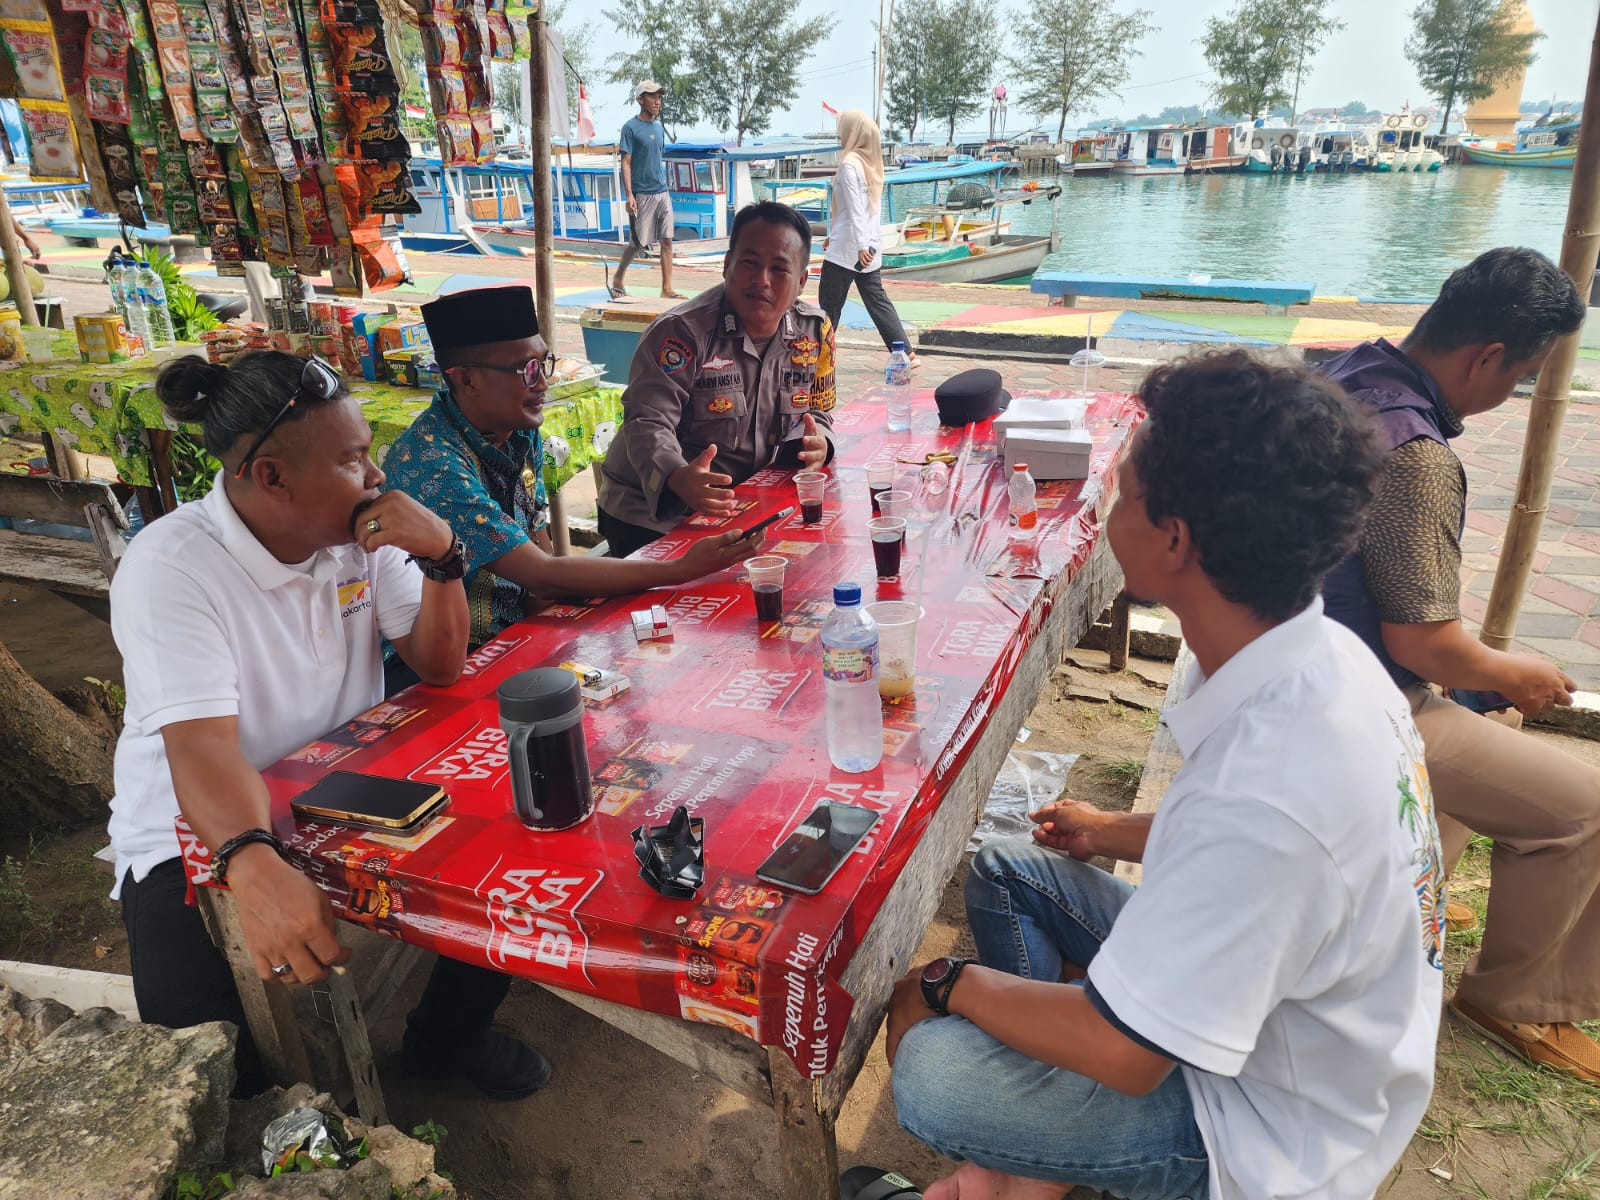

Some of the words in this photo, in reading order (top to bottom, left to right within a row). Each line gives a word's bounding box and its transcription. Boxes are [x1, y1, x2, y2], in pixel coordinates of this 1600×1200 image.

[23, 111, 48, 124] Good
[48, 113, 69, 127] Day
[341, 601, 372, 619] akarta
[677, 596, 731, 625] TORA
[940, 620, 985, 655] TORA
[971, 622, 1013, 657] BIKA
[706, 668, 769, 709] TORA
[739, 671, 799, 711] BIKA
[424, 727, 506, 776] BIKA
[453, 740, 509, 780] ORA
[727, 743, 758, 769] Kopi
[645, 771, 699, 820] Sepenuh
[690, 754, 720, 781] Hati
[174, 815, 213, 885] ORA
[488, 868, 548, 964] TORA
[525, 876, 586, 970] BIKA
[698, 915, 726, 948] 3inONE
[785, 931, 820, 972] Hati
[782, 971, 807, 1057] Sepenuh
[807, 1033, 829, 1080] ntuk
